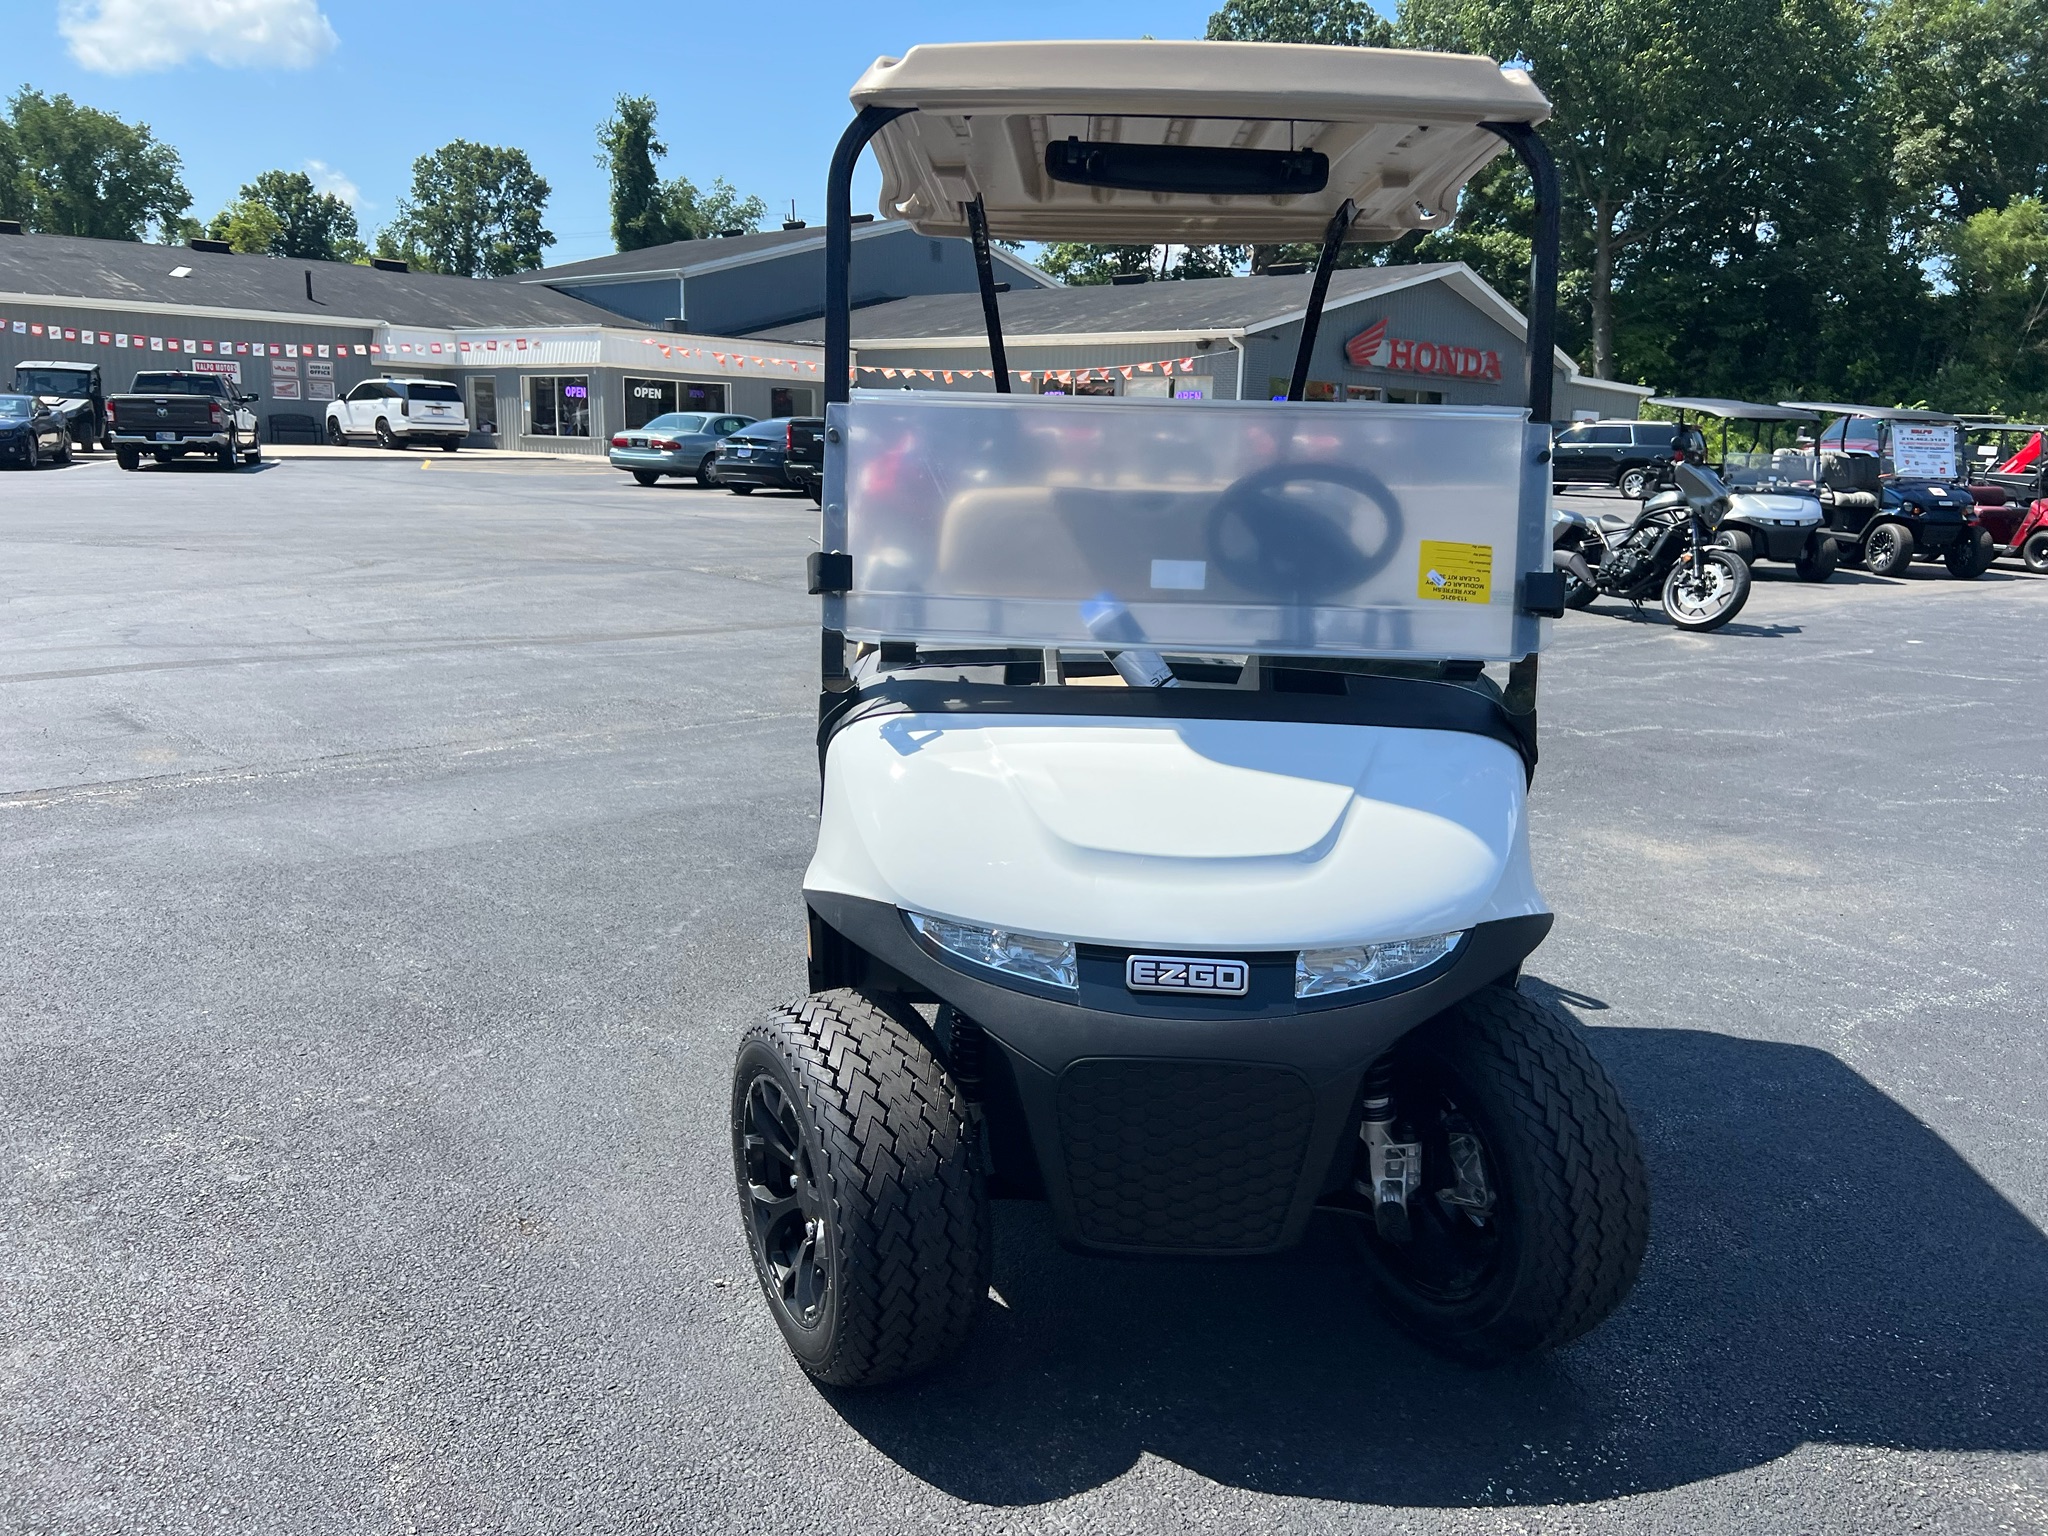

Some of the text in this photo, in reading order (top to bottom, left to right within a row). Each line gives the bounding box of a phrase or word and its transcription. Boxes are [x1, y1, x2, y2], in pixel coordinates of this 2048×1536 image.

[1387, 337, 1502, 380] HONDA
[196, 363, 237, 372] VALPO MOTORS
[565, 385, 587, 398] OPEN
[634, 387, 662, 399] OPEN
